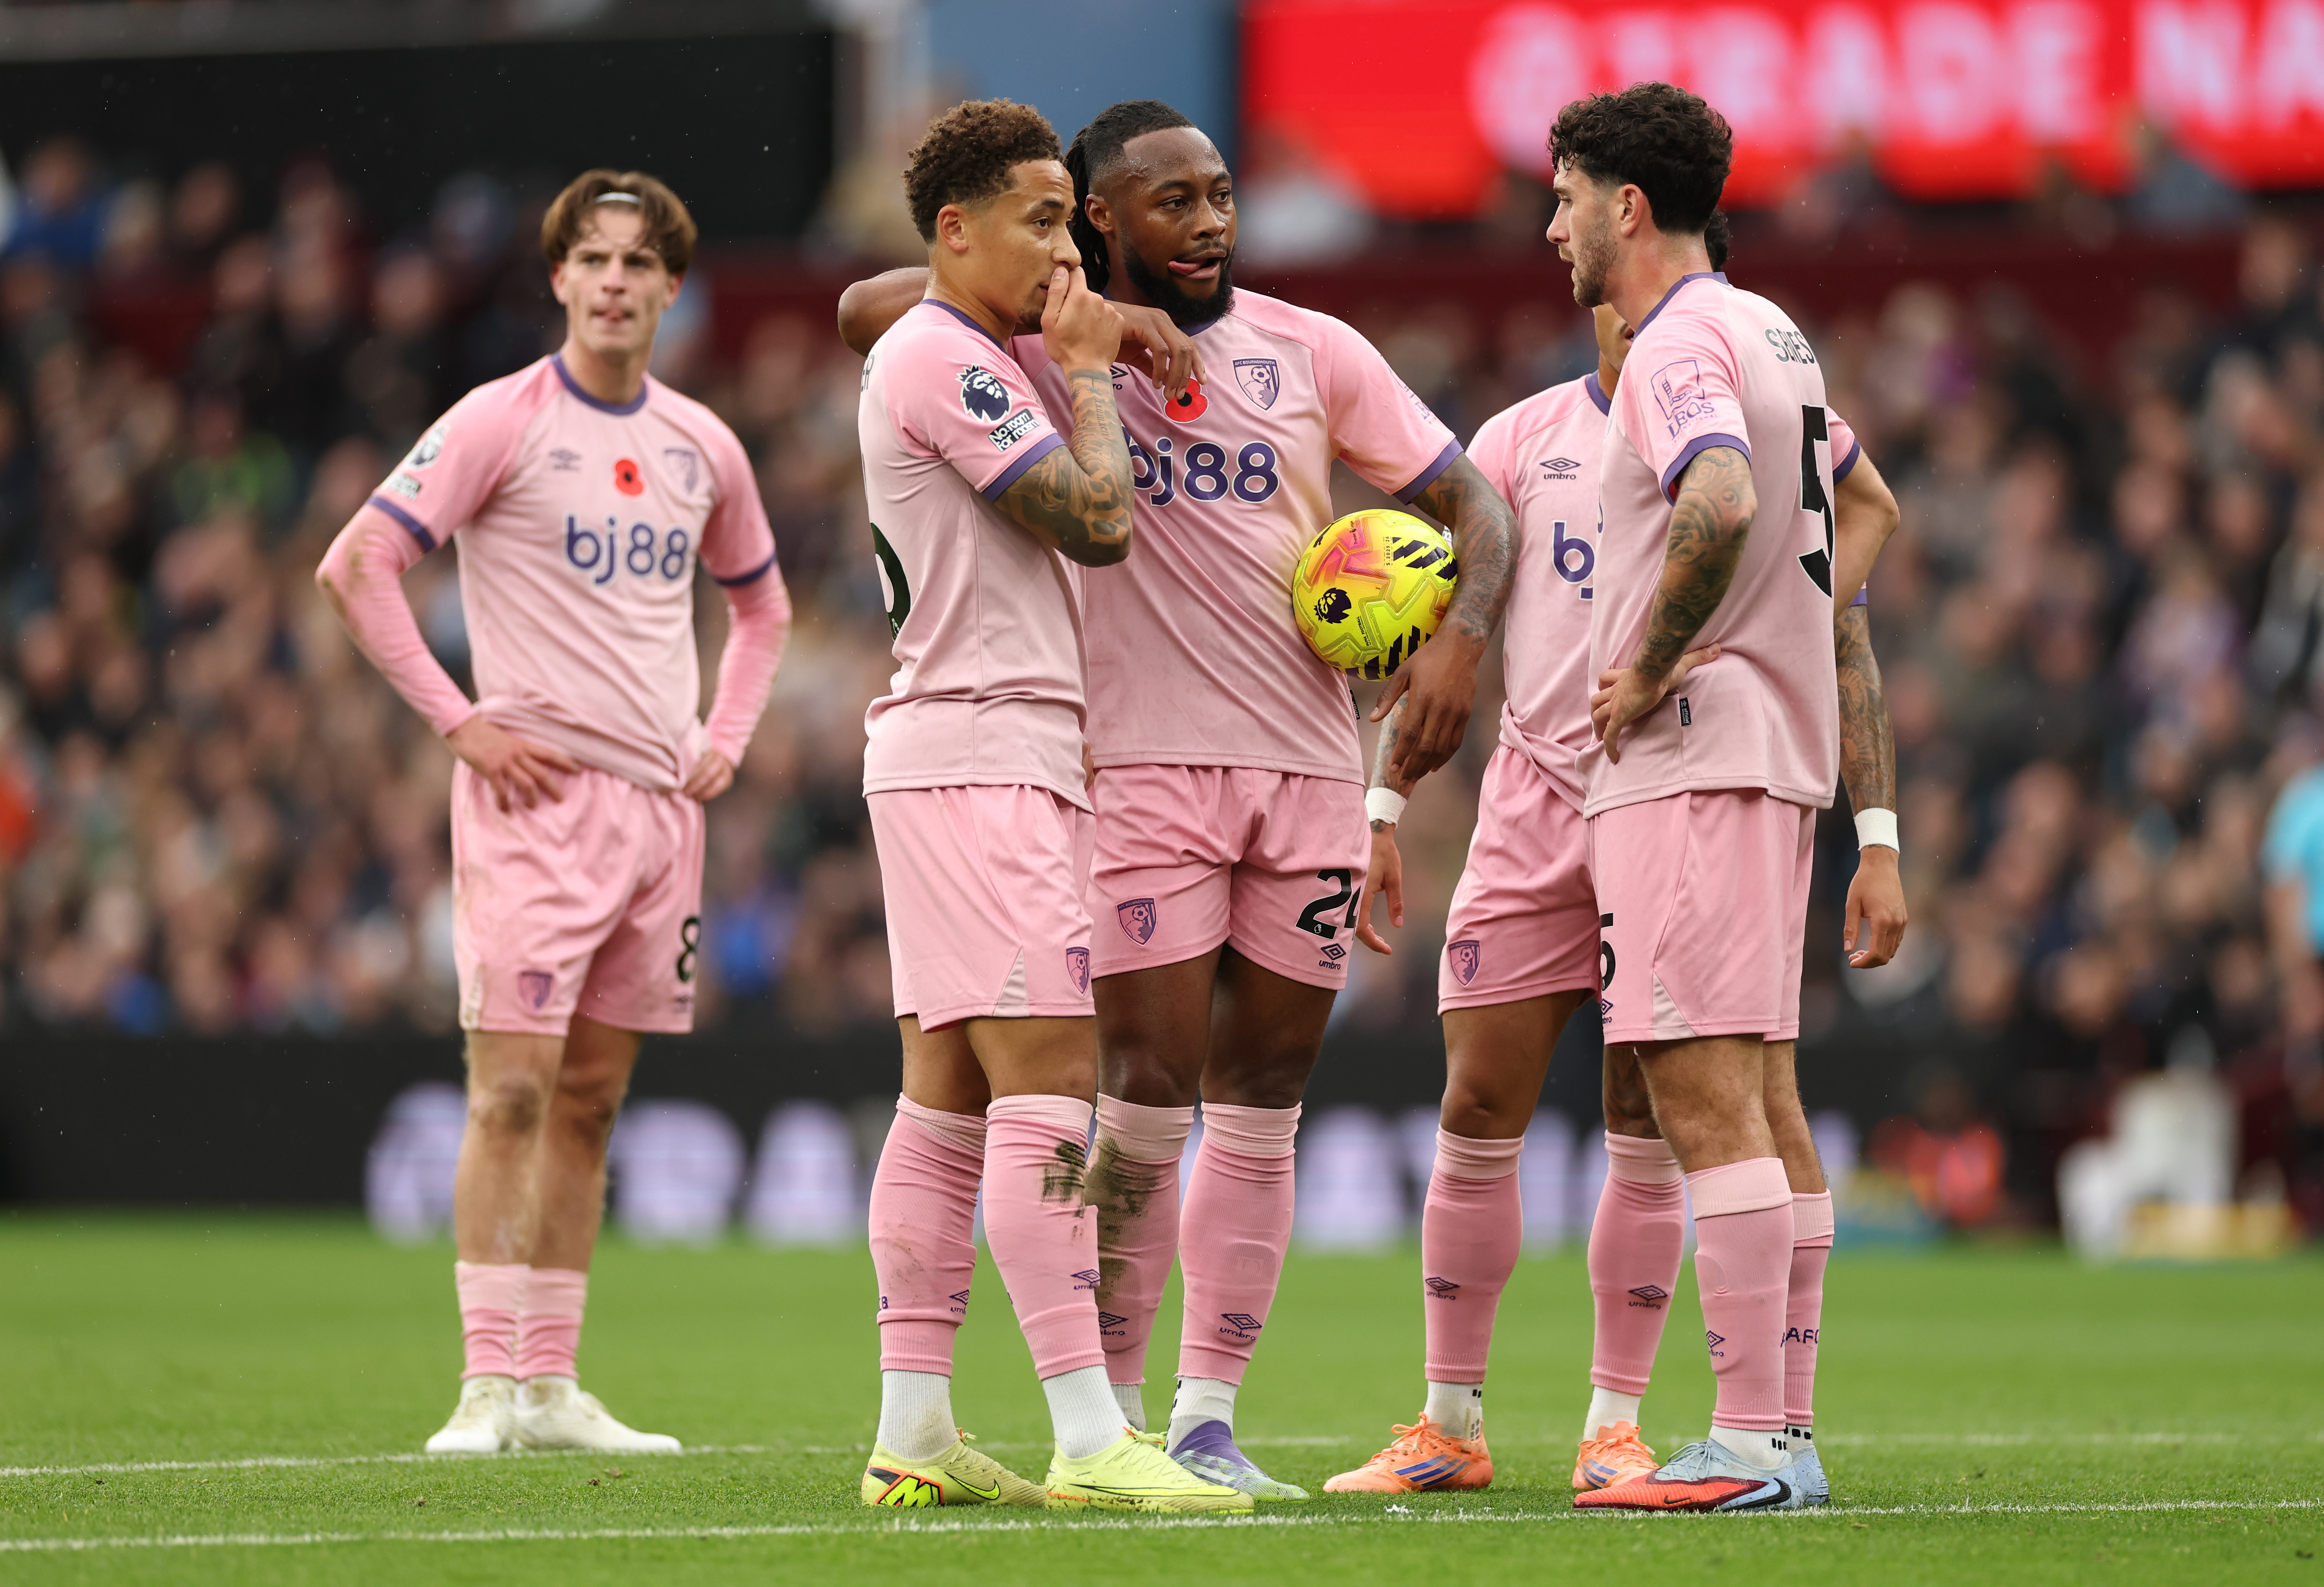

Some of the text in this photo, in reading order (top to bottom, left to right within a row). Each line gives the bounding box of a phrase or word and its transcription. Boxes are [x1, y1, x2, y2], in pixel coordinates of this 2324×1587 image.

[1764, 328, 1815, 364] SENES
[1005, 412, 1030, 431] room
[1667, 402, 1715, 441] LEOS
[996, 434, 1014, 452] for
[566, 514, 689, 585] bj88
[1356, 616, 1365, 635] FOOTBALL
[677, 916, 700, 983] 8
[1319, 960, 1341, 970] umbro
[1602, 1016, 1612, 1024] bro
[1426, 1291, 1456, 1300] umbro
[1628, 1300, 1661, 1310] umbro
[1219, 1327, 1256, 1341] umbro
